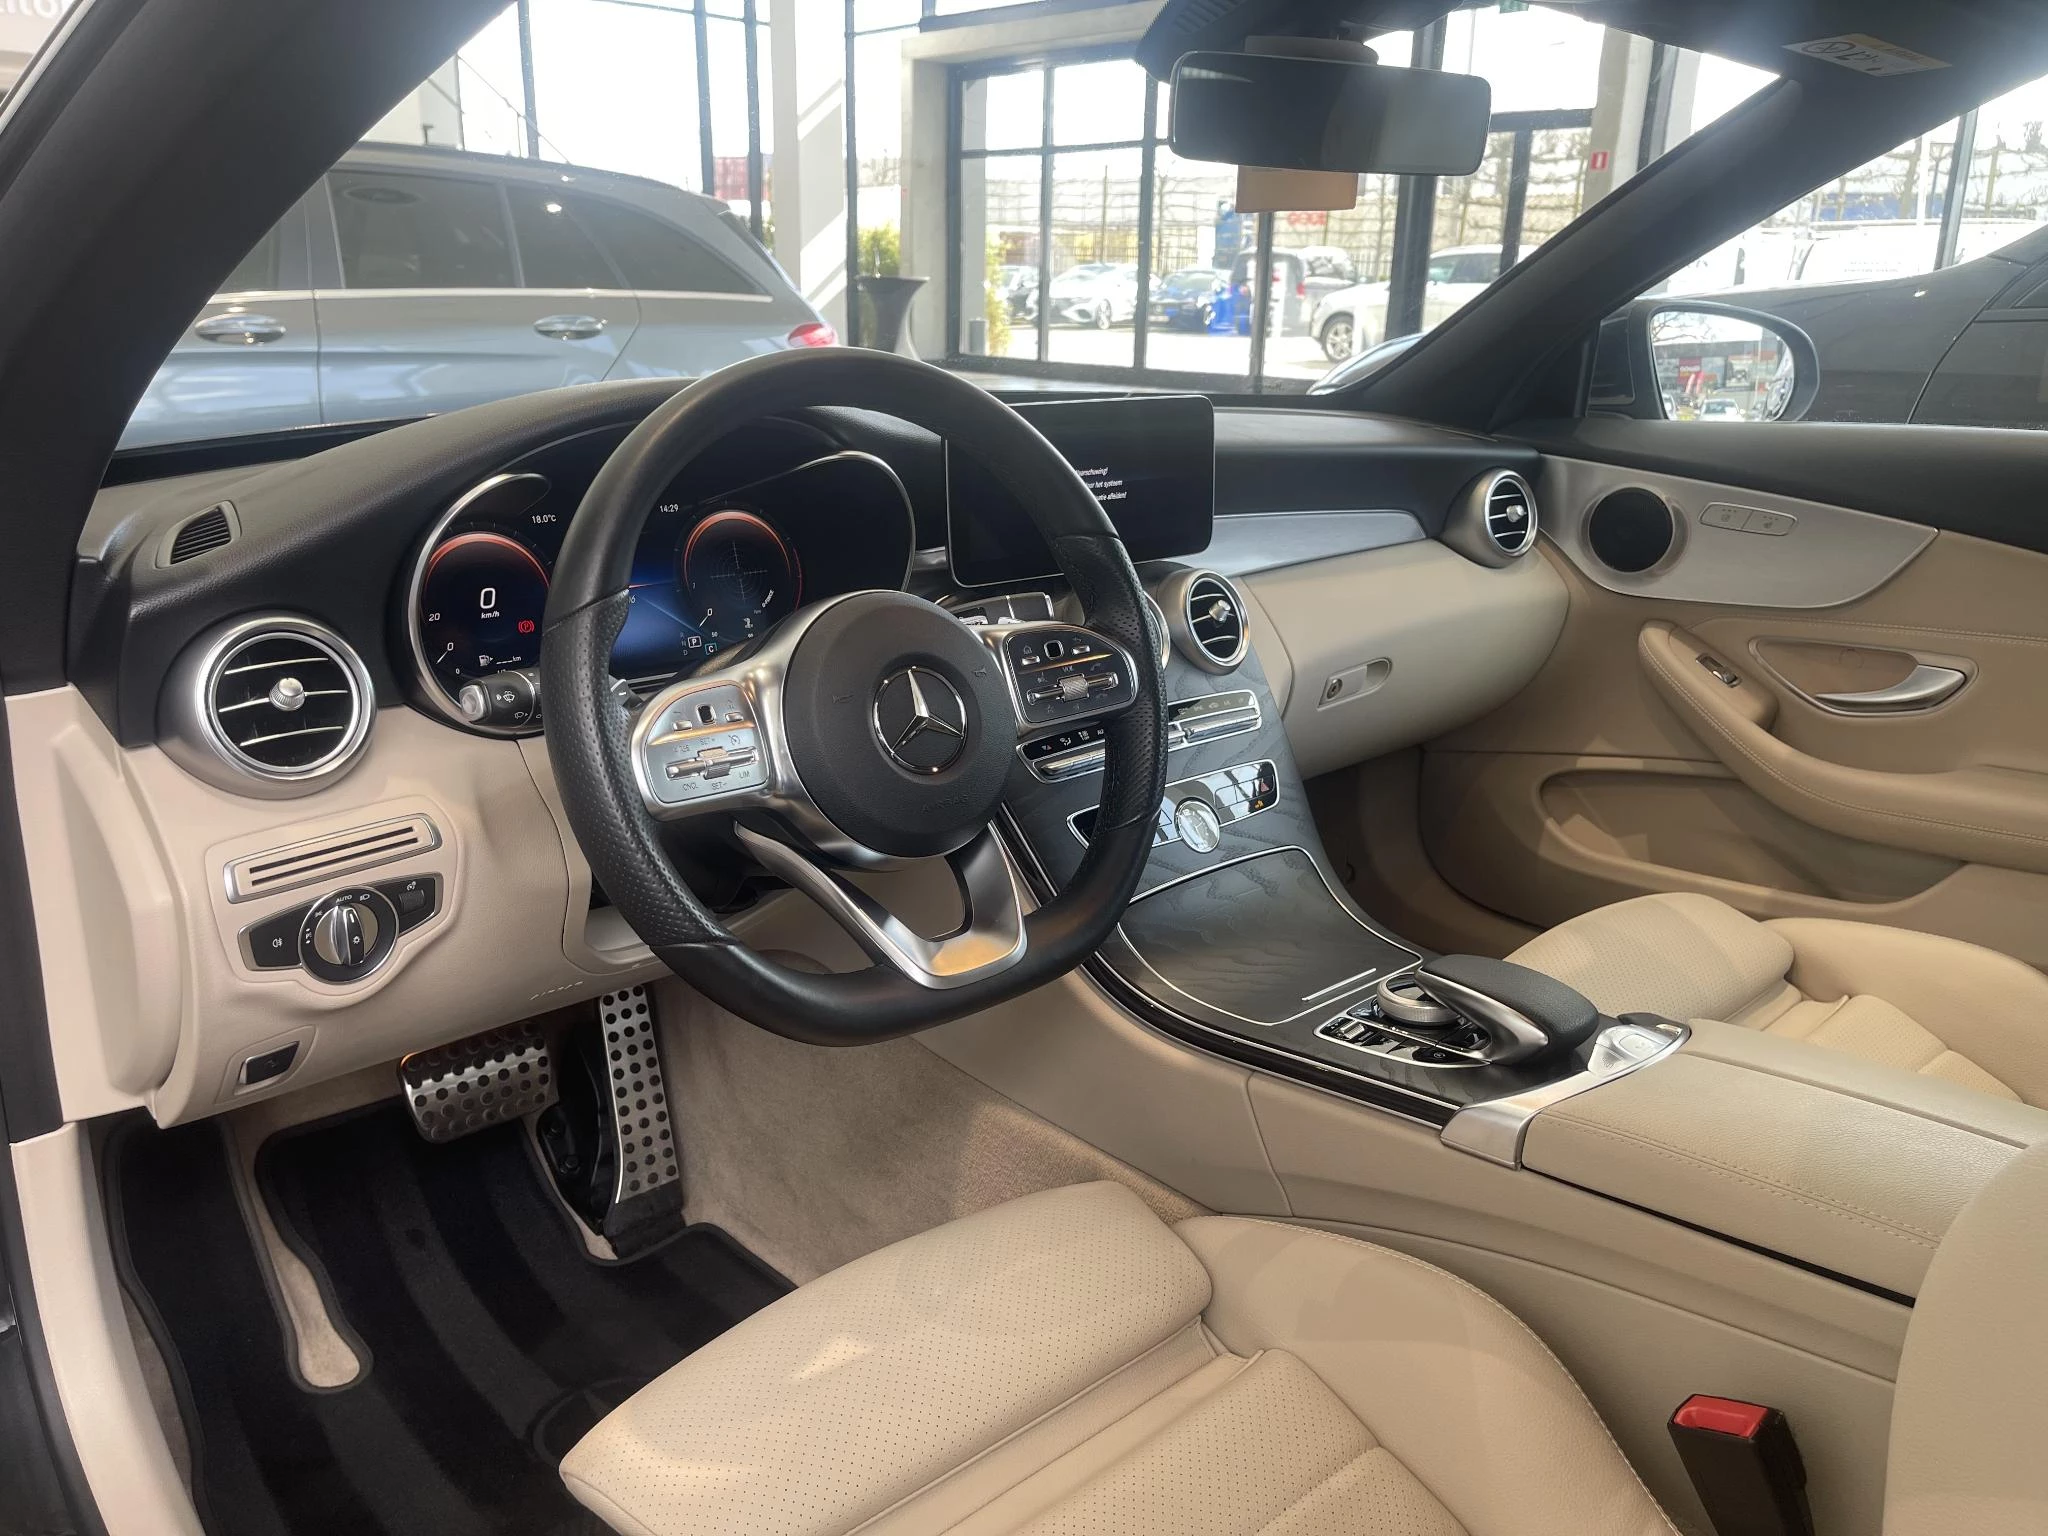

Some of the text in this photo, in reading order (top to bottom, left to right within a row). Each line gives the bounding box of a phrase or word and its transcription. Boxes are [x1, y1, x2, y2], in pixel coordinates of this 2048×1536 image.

[1103, 480, 1123, 489] systeem
[659, 504, 679, 513] 14:29
[479, 587, 496, 609] 0
[428, 612, 441, 622] 20
[480, 611, 500, 620] km/h
[707, 608, 713, 617] 0
[447, 642, 454, 651] 0
[335, 894, 353, 903] AUTO
